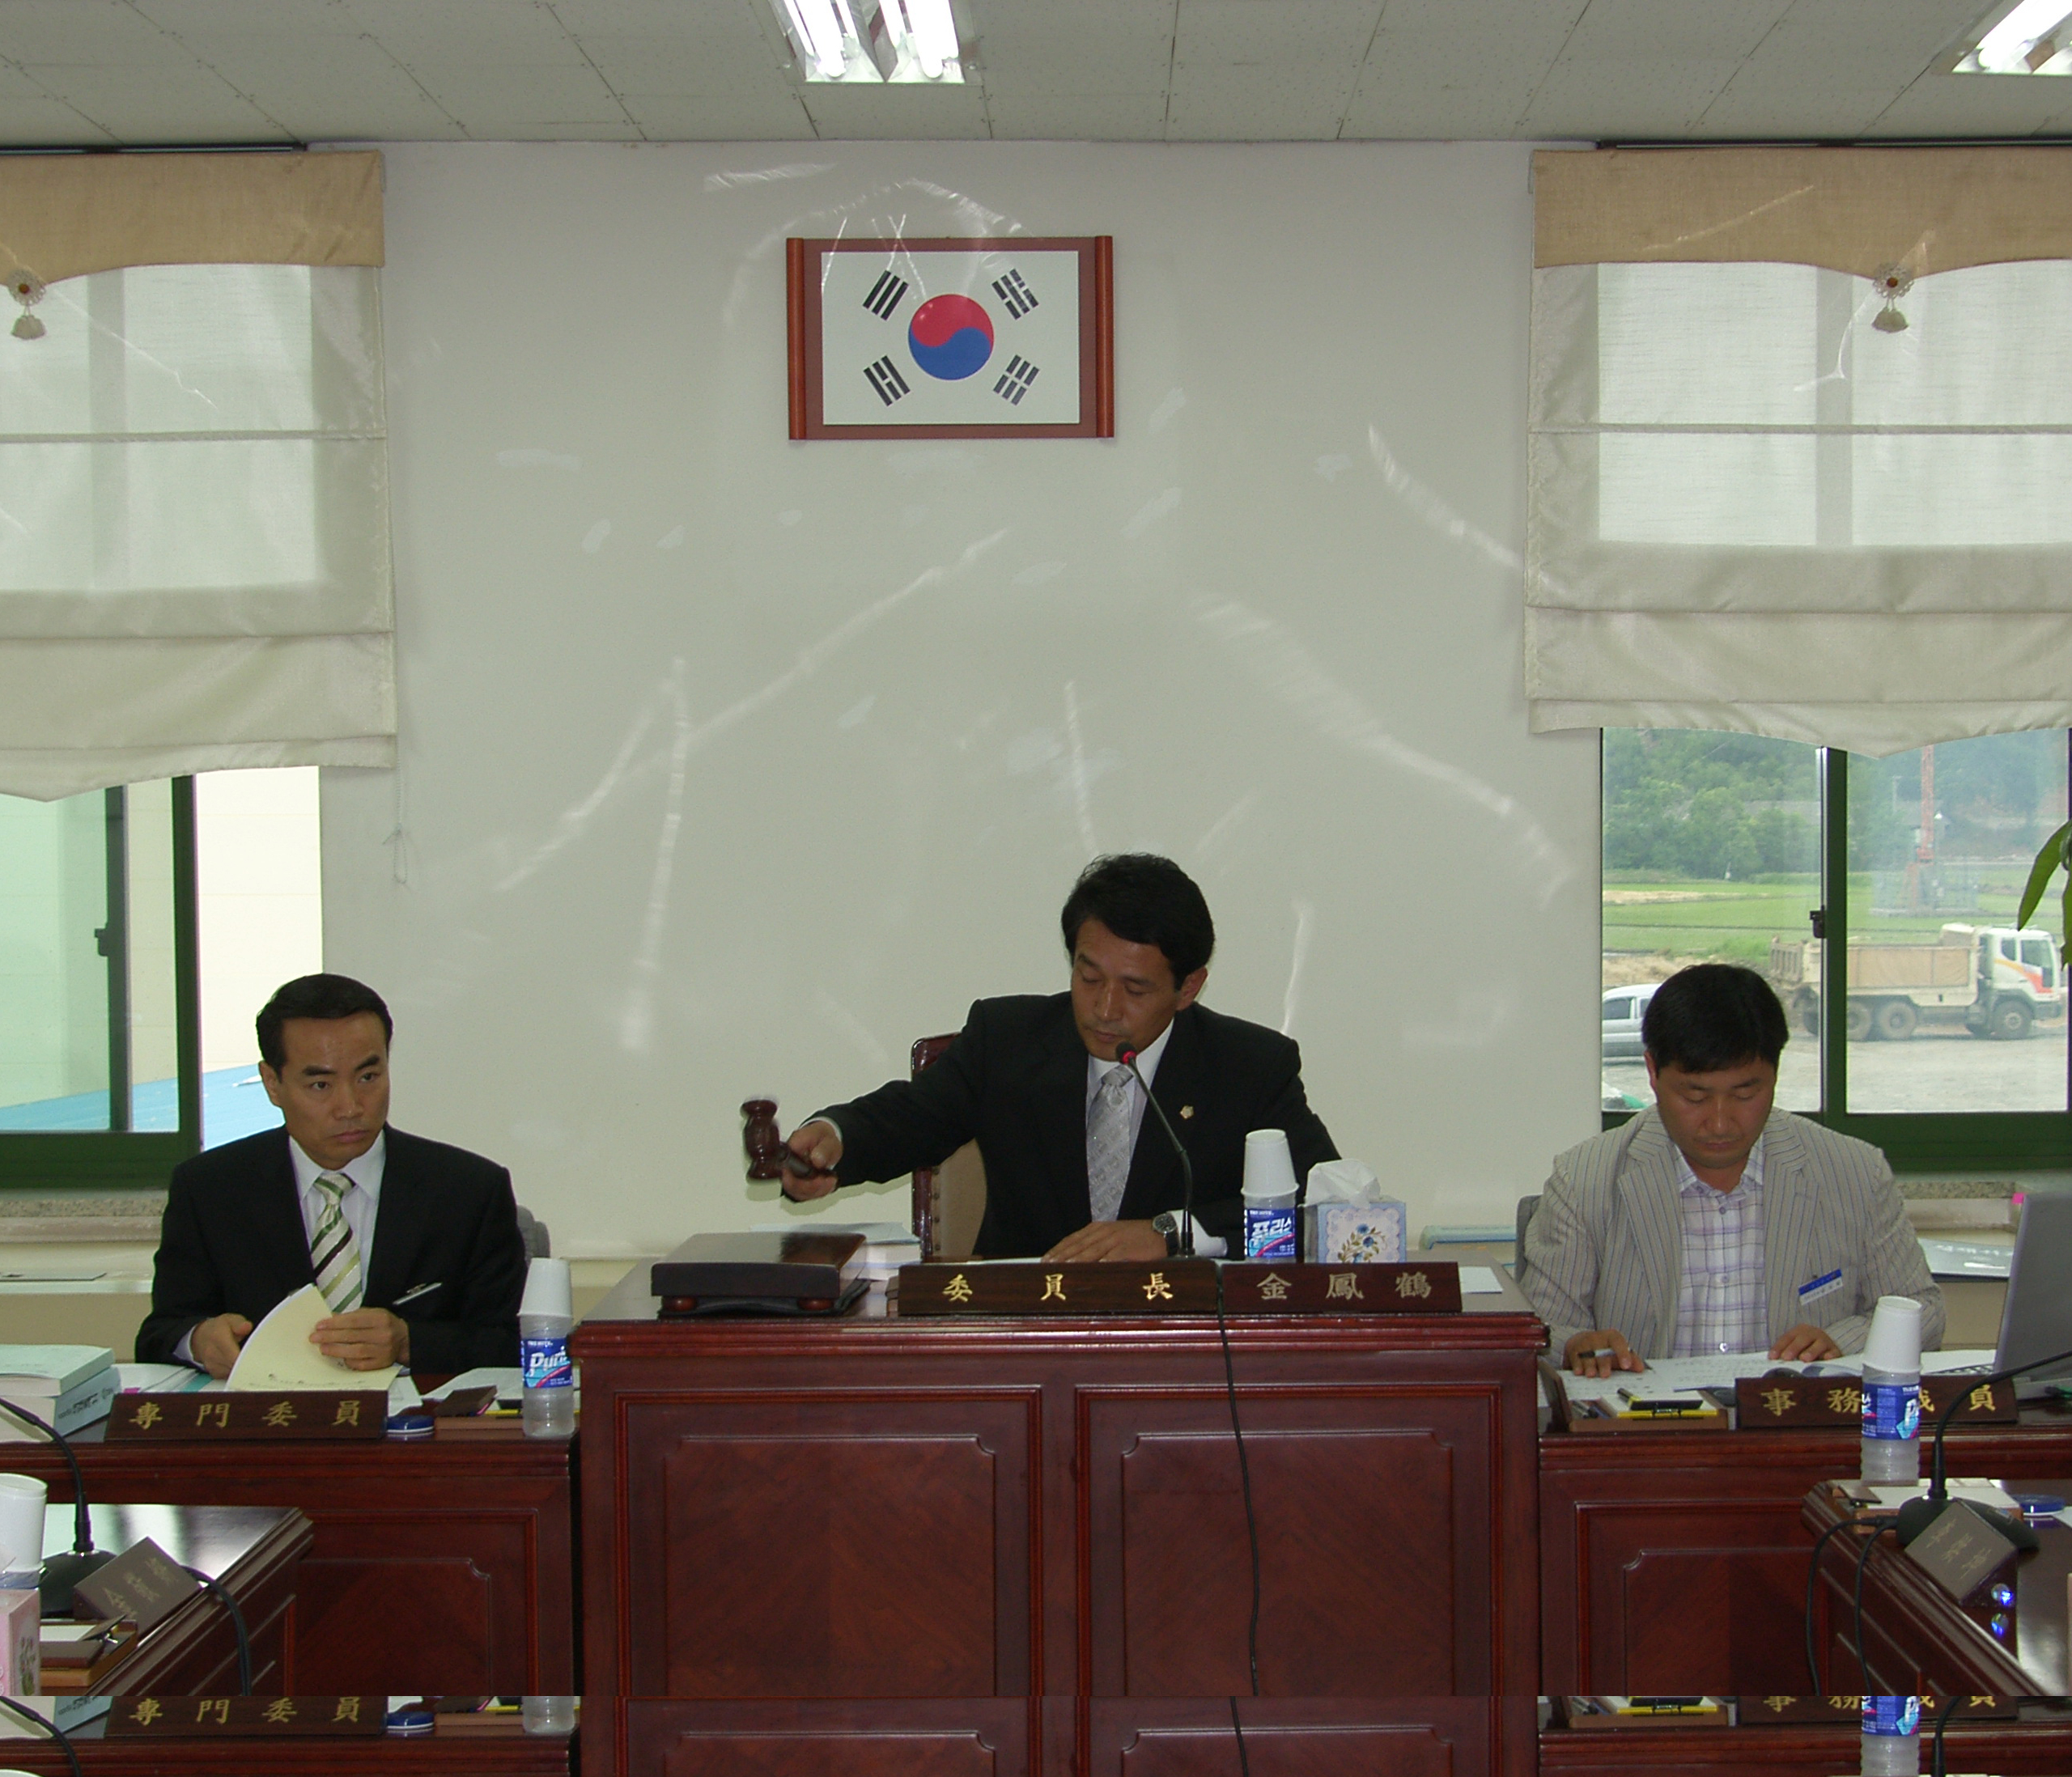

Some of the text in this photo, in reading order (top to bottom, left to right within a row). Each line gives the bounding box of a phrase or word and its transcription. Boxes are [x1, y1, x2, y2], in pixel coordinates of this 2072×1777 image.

[1251, 1216, 1293, 1248] 퓨리스
[942, 1273, 1174, 1301] 委員長
[1256, 1271, 1432, 1300] 金鳳鶴
[129, 1400, 362, 1430] 專門委員
